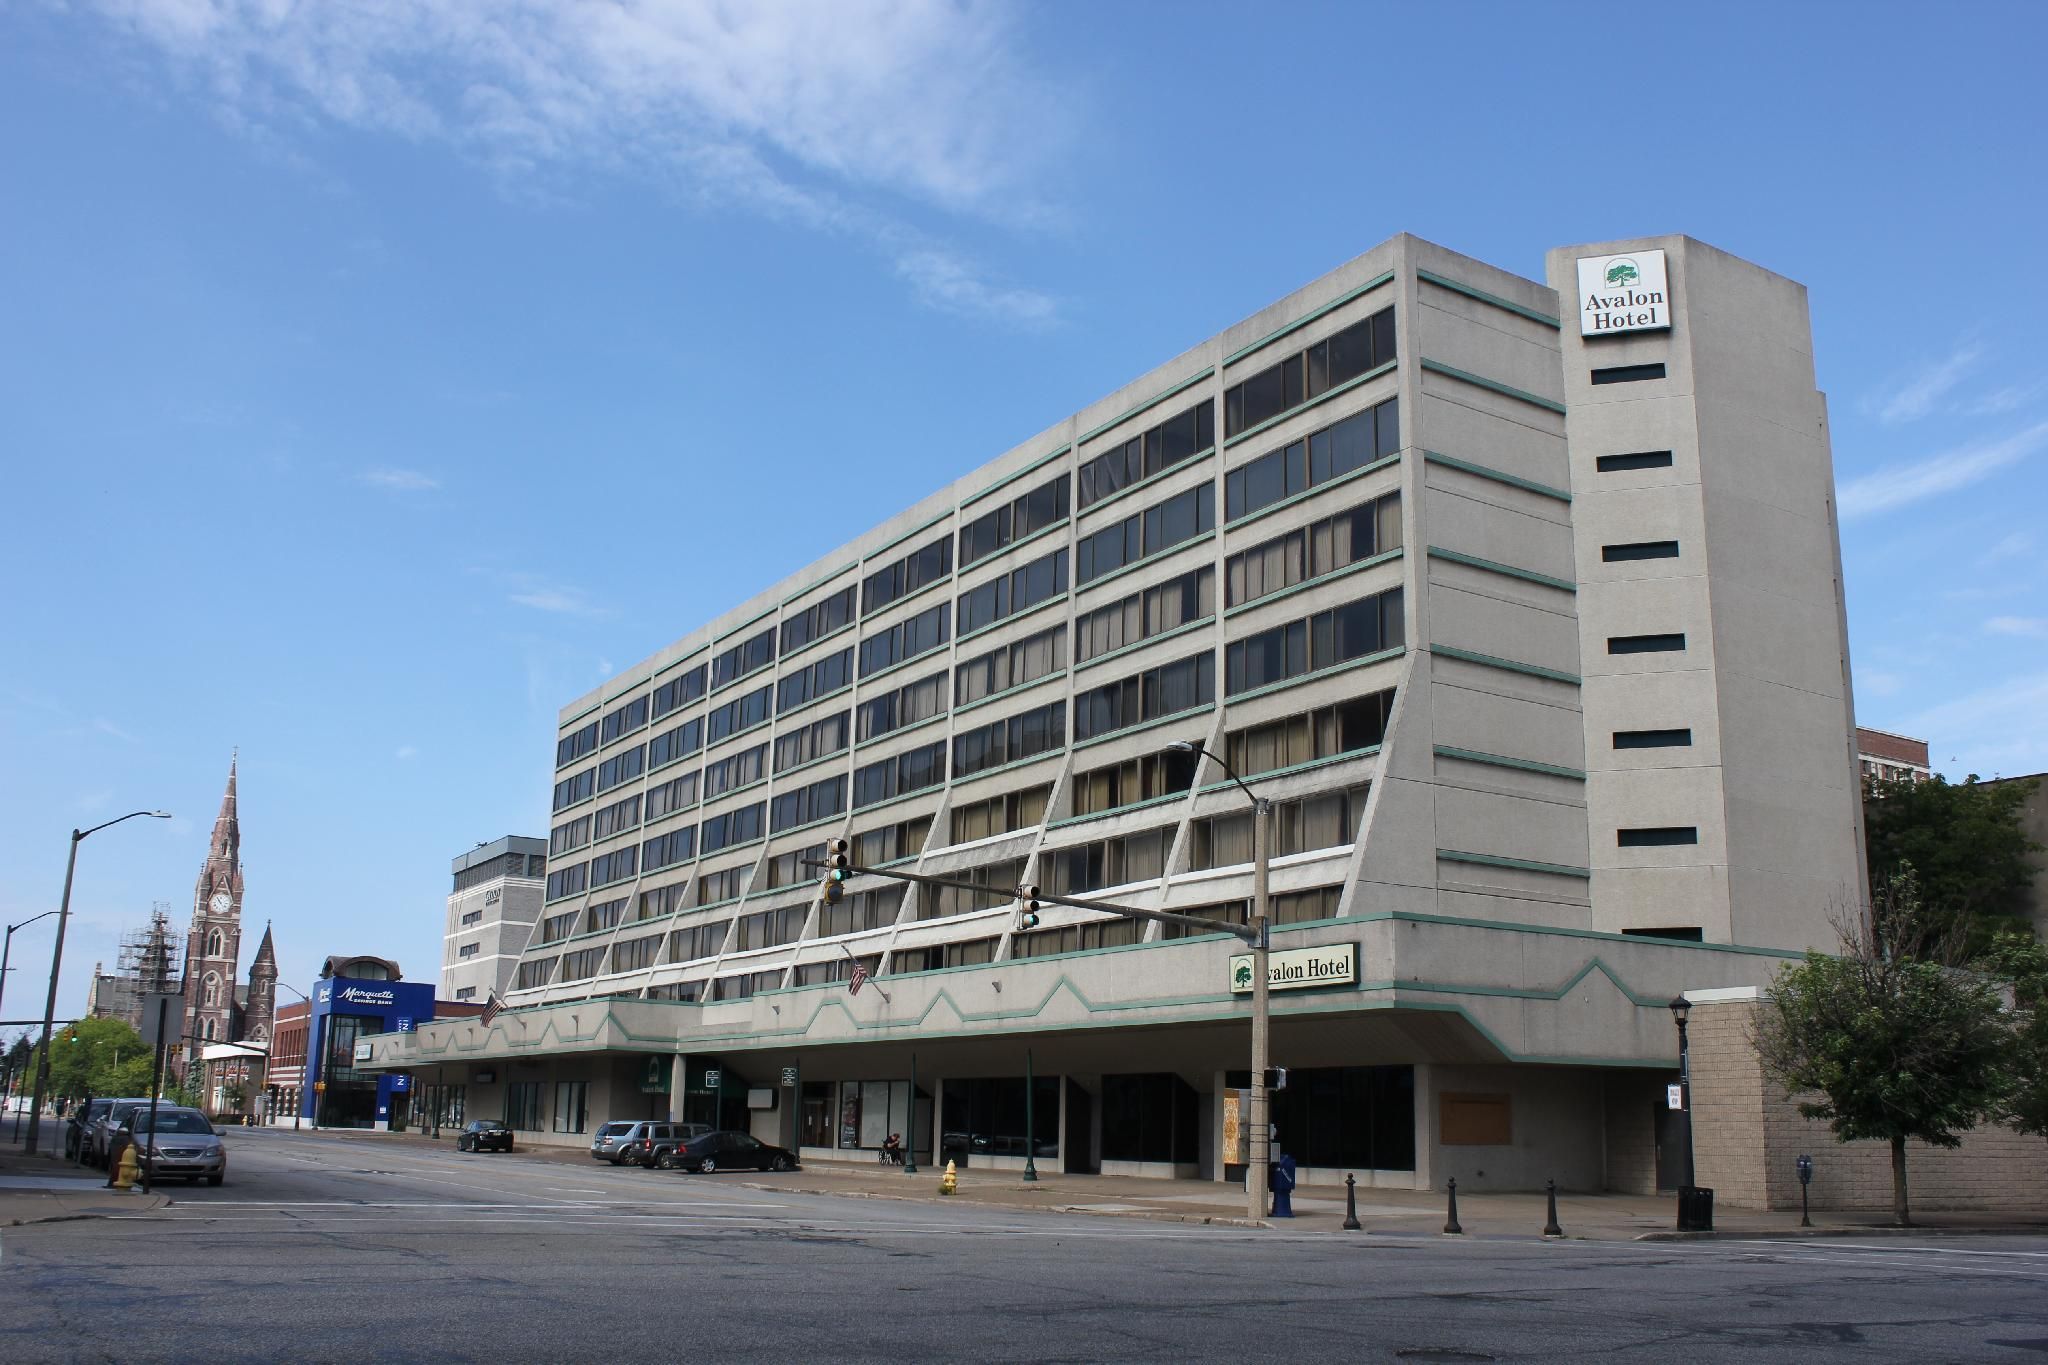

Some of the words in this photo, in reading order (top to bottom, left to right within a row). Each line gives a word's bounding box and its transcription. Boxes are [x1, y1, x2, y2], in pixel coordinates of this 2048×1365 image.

[1585, 290, 1663, 311] Avalon
[1593, 308, 1657, 329] Hotel
[1307, 955, 1350, 977] Hotel
[337, 987, 394, 1002] Marquette
